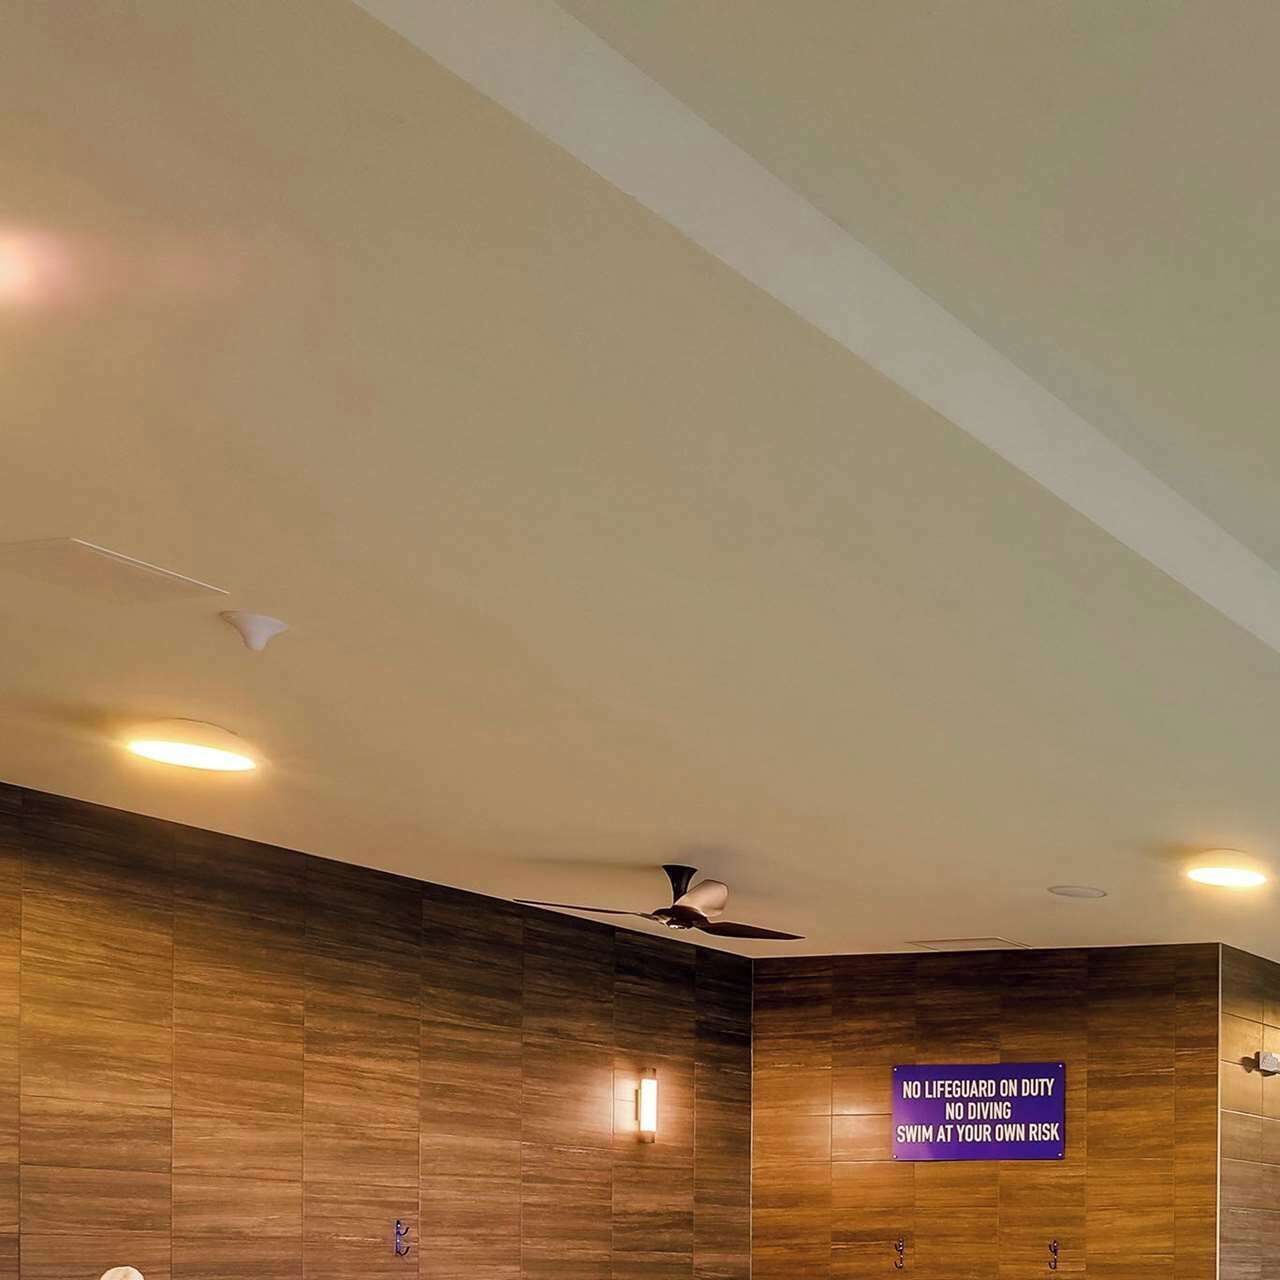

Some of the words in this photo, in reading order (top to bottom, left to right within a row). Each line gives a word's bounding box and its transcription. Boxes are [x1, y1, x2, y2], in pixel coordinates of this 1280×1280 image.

[903, 1081, 921, 1099] NO
[925, 1080, 996, 1099] LIFEGUARD
[1000, 1079, 1018, 1097] ON
[1021, 1078, 1055, 1097] DUTY
[945, 1102, 964, 1120] NO
[968, 1101, 1012, 1120] DIVING
[896, 1125, 933, 1143] SWIM
[936, 1124, 953, 1142] AT
[956, 1124, 991, 1142] YOUR
[995, 1124, 1025, 1141] OWN
[1029, 1123, 1060, 1141] RISK
